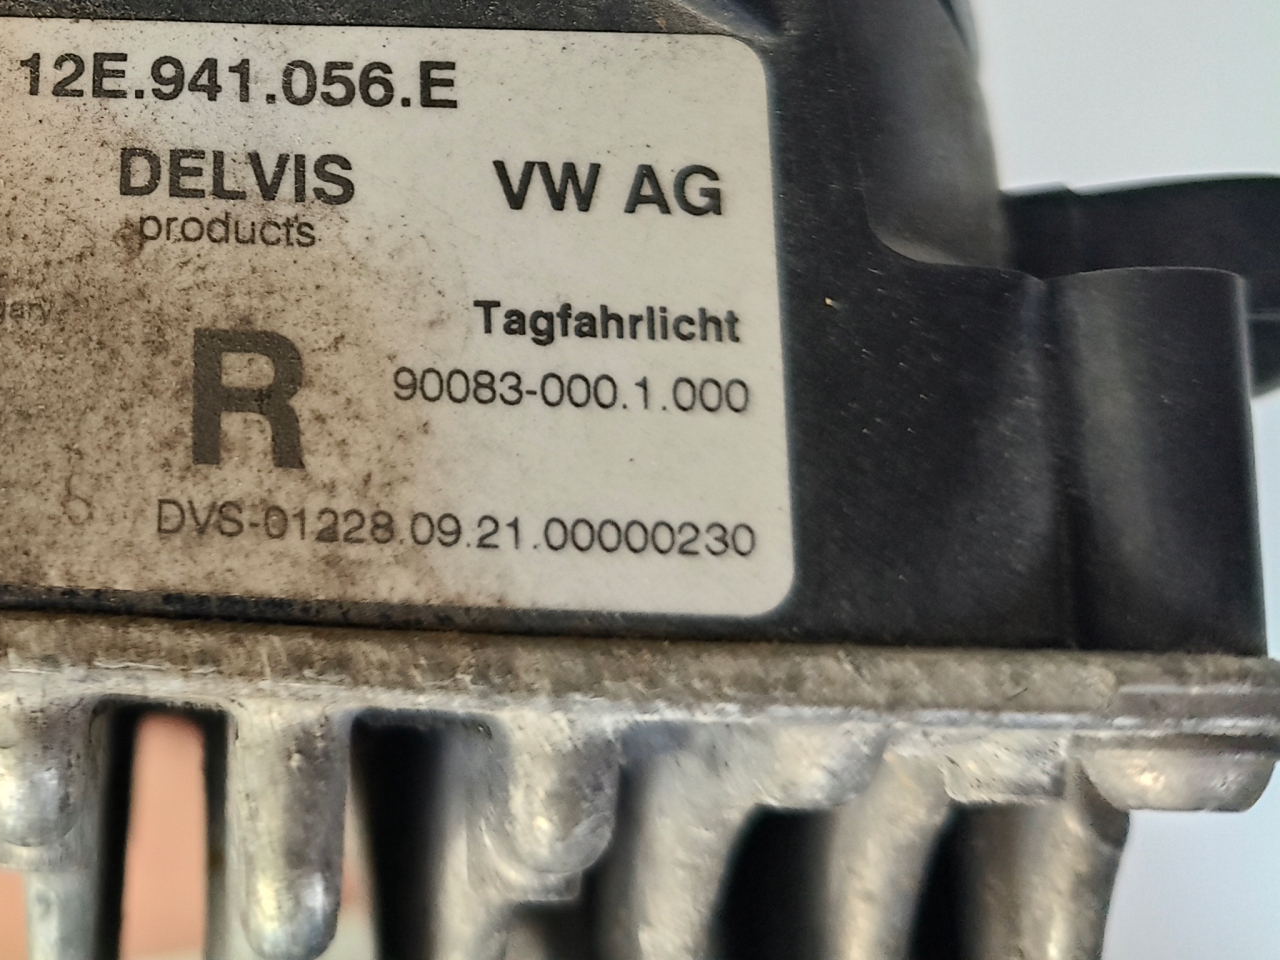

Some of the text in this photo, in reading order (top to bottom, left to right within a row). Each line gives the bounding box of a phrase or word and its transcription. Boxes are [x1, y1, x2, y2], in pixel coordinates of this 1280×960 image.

[19, 52, 458, 110] 12E.941.056.E
[119, 146, 355, 205] DELVIS
[493, 159, 723, 217] VW AG
[139, 212, 317, 249] products
[473, 299, 742, 347] Tagfahrlicht
[192, 326, 306, 471] R
[393, 366, 750, 415] 90083-000.1.000
[157, 497, 757, 559] DVS-01228.09.21.00000230
